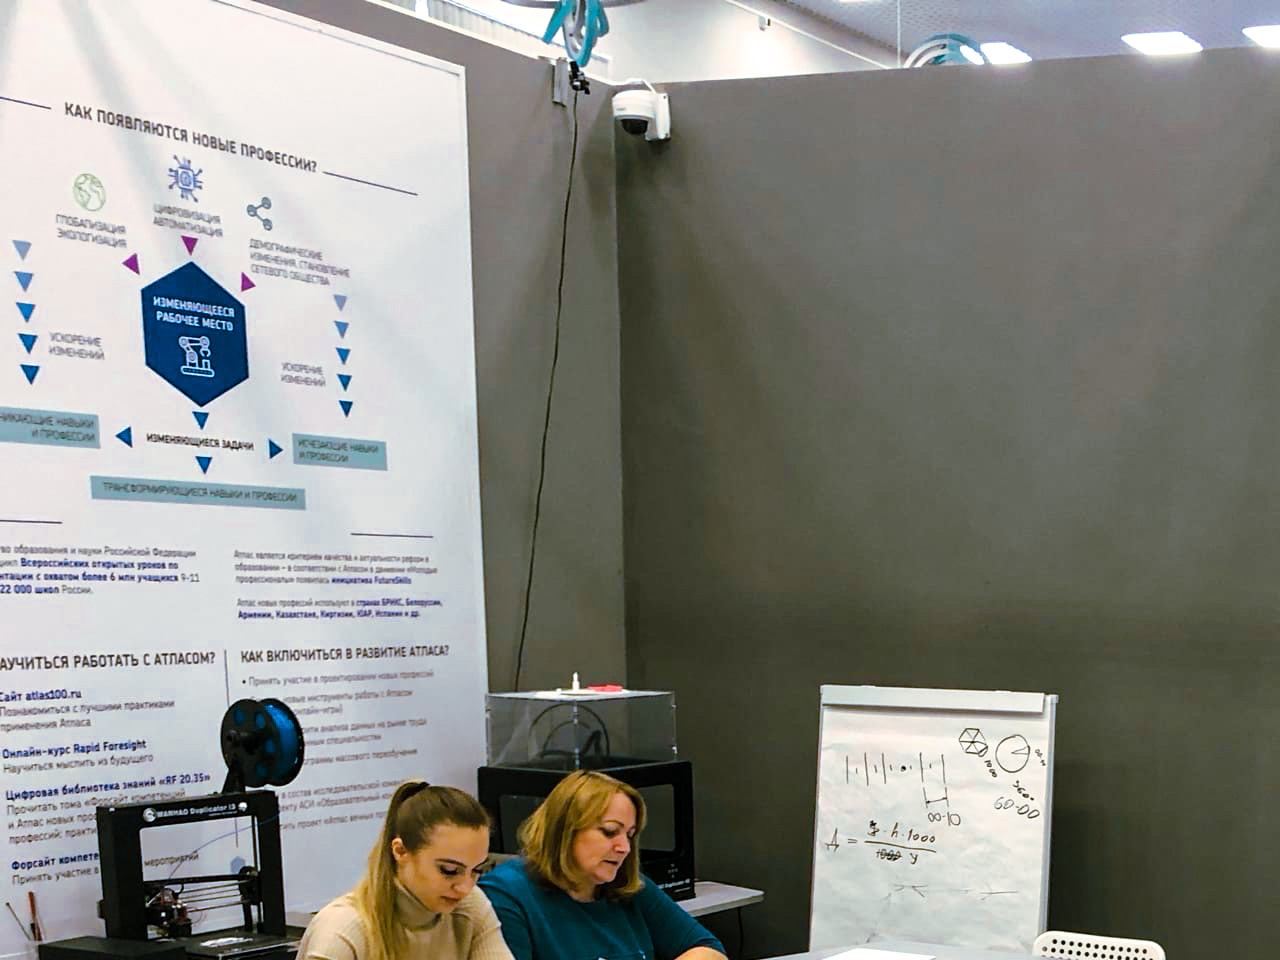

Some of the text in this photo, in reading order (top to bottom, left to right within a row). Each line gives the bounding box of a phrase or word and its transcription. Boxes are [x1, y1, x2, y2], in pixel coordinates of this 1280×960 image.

[64, 102, 317, 173] КАК ПОЯВЛЯЮТСЯ НОВЫЕ ПРОФЕССИИ?
[152, 295, 235, 318] ИЗМЕНЯЮЩЕЕСЯ
[156, 310, 234, 331] РАБОЧЕЕ МЕСТО
[146, 432, 255, 451] ИЗМЕНЯЮЩИЕСЯ ЗАДАЧИ
[20, 557, 89, 568] Всероссийских
[92, 561, 134, 570] открытых
[168, 562, 179, 570] по
[0, 584, 12, 594] 22
[14, 584, 32, 594] 000
[34, 586, 60, 594] школ
[0, 651, 216, 670] АУЧИТЬСЯ РАБОТАТЬ С АТЛАСОМ?
[241, 644, 449, 663] КАК ВКЛЮЧИТЬСЯ В РАЗВИТИЕ АТЛАСА?
[25, 688, 82, 701] atlas100.ru
[2, 739, 147, 759] Онлайн-курс Rapid Foresight
[6, 787, 58, 801] Цифровая
[62, 782, 120, 796] библиотека
[123, 776, 156, 790] знаний
[179, 772, 211, 785] 20.35»
[11, 852, 100, 871] Форсайт компете
